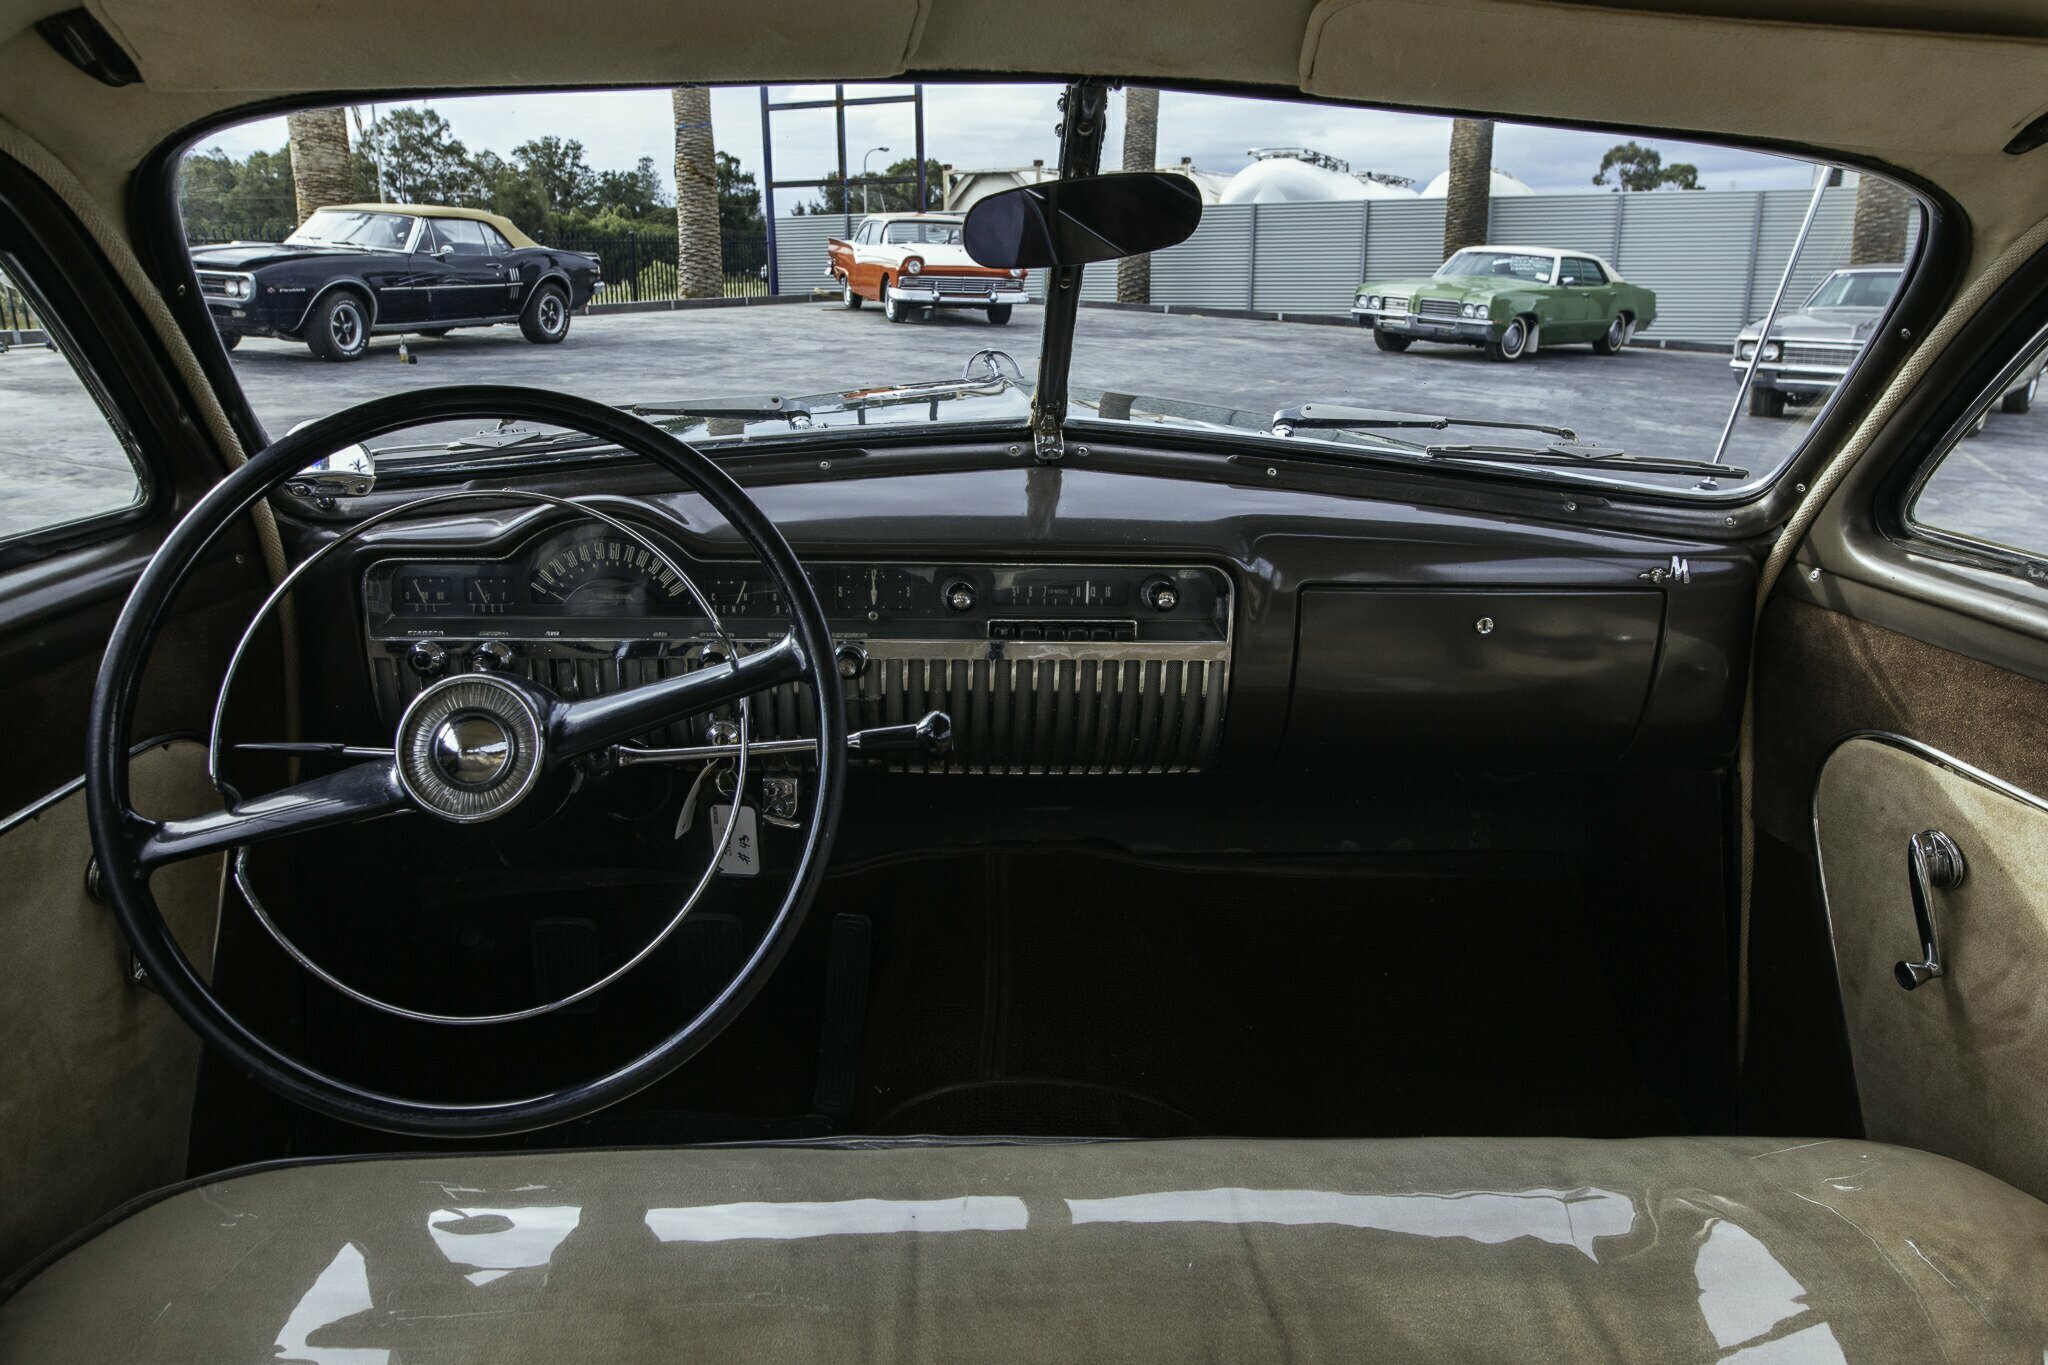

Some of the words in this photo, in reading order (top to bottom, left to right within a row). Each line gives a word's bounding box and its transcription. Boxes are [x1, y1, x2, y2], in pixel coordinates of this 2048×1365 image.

[562, 550, 579, 568] 30
[578, 545, 591, 562] 40
[594, 542, 606, 560] 50
[609, 542, 621, 560] 60
[623, 544, 636, 562] 70
[635, 549, 650, 568] 80
[549, 558, 566, 577] 20
[647, 556, 663, 575] 90
[1671, 555, 1691, 584] M
[538, 569, 555, 585] 10
[530, 582, 547, 594] 0
[415, 603, 437, 613] OIL
[472, 603, 505, 613] FUEL
[714, 605, 746, 614] TEMP
